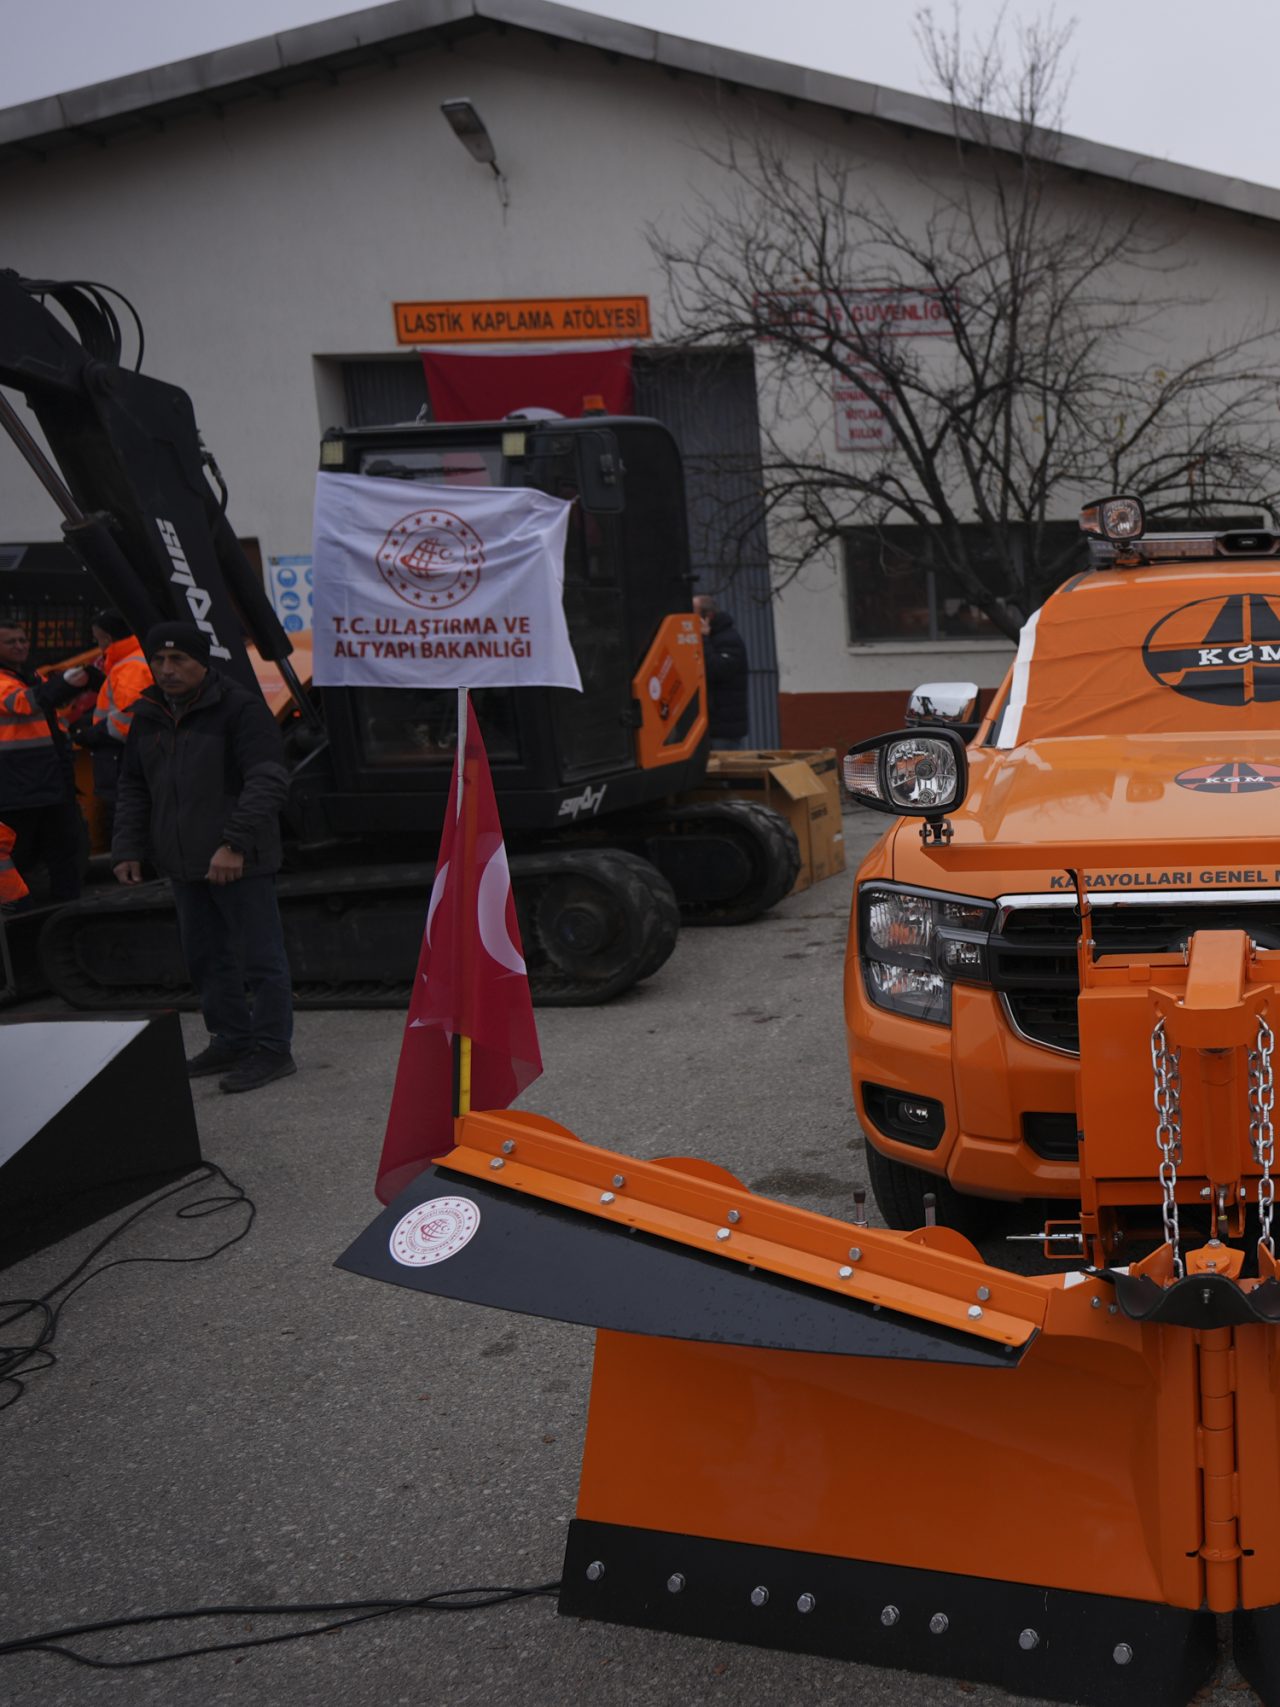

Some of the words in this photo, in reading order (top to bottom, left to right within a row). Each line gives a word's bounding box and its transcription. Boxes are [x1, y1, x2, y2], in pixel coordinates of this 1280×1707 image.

[403, 307, 464, 334] LASTİK
[471, 309, 554, 332] KAPLAMA
[562, 304, 641, 330] ATÖLYESİ
[332, 616, 371, 634] T.C.
[375, 616, 498, 639] ULAŞTIRMA
[503, 616, 531, 634] VE
[334, 640, 416, 658] ALTYAPI
[421, 637, 532, 658] BAKANLIĞI
[1205, 775, 1266, 784] KGM
[1049, 871, 1193, 889] KARAYOLLARI
[1199, 870, 1269, 884] GENEL
